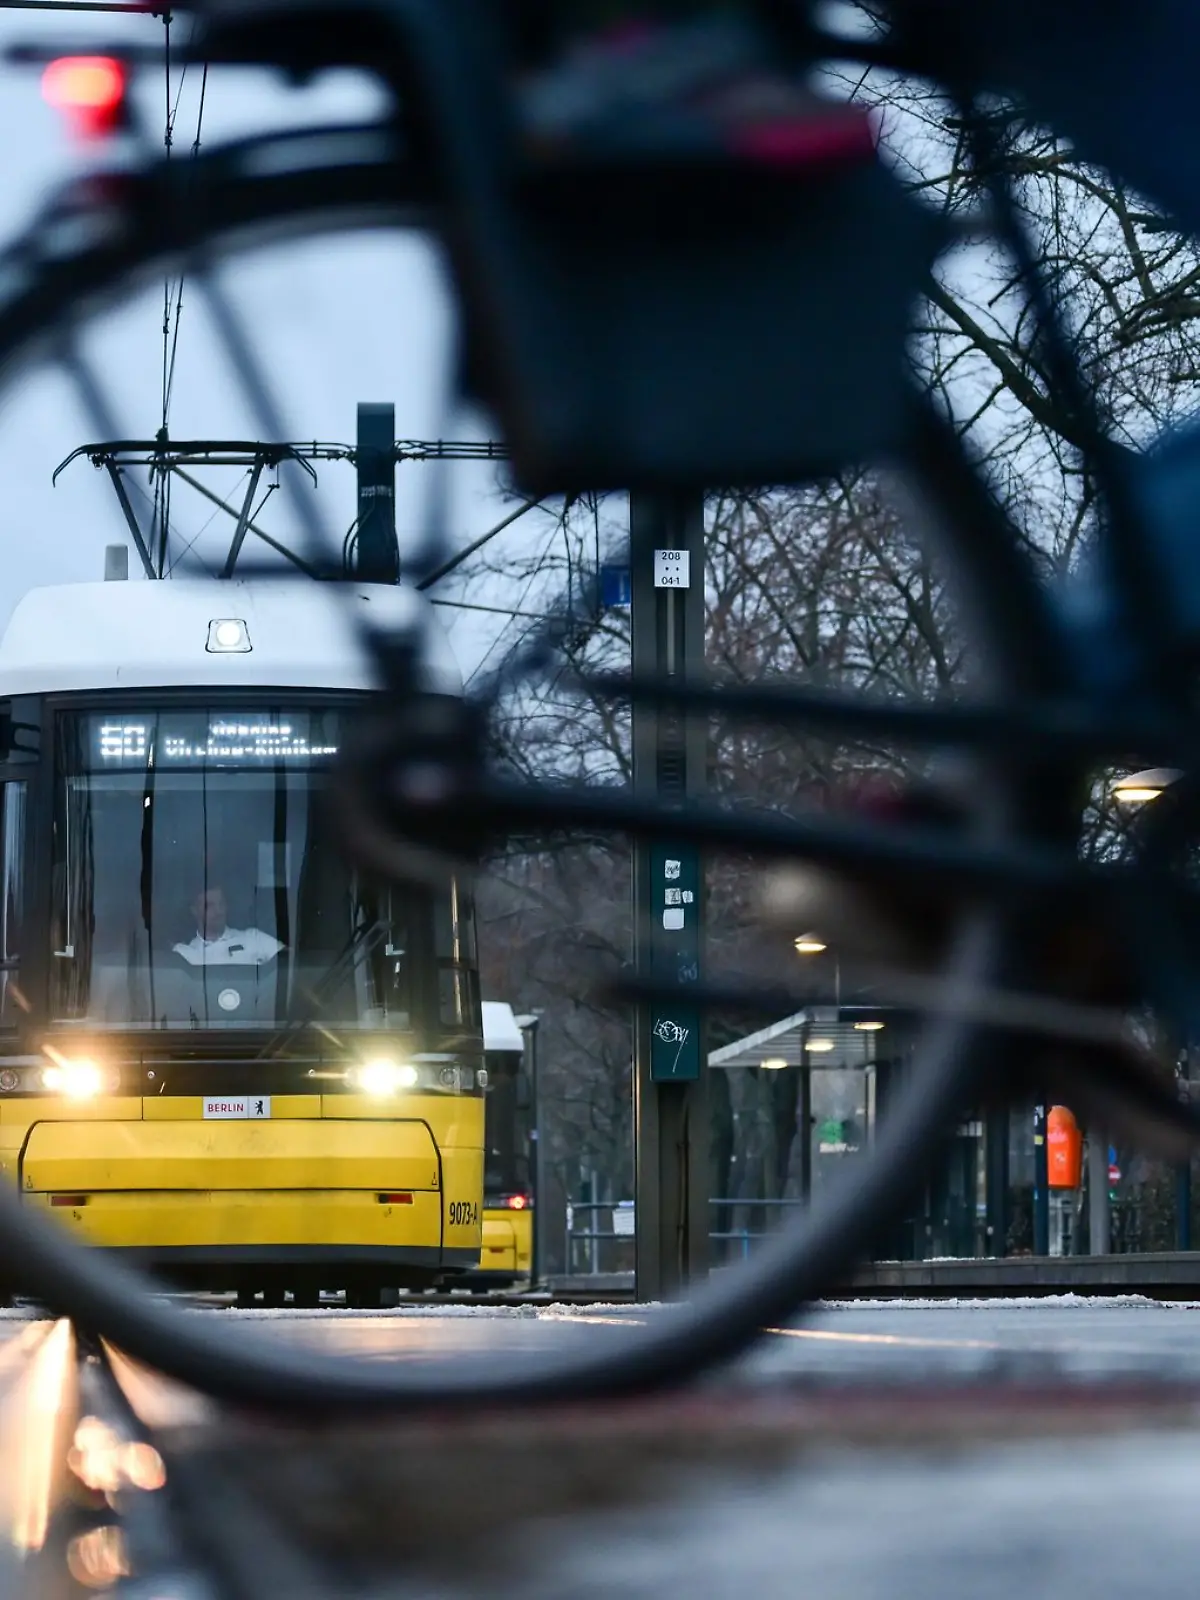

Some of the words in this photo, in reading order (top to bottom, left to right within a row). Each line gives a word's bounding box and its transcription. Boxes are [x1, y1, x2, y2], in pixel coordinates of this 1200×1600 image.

[661, 551, 681, 561] 208
[208, 1103, 244, 1112] BERLIN
[449, 1201, 478, 1226] 9073-A
